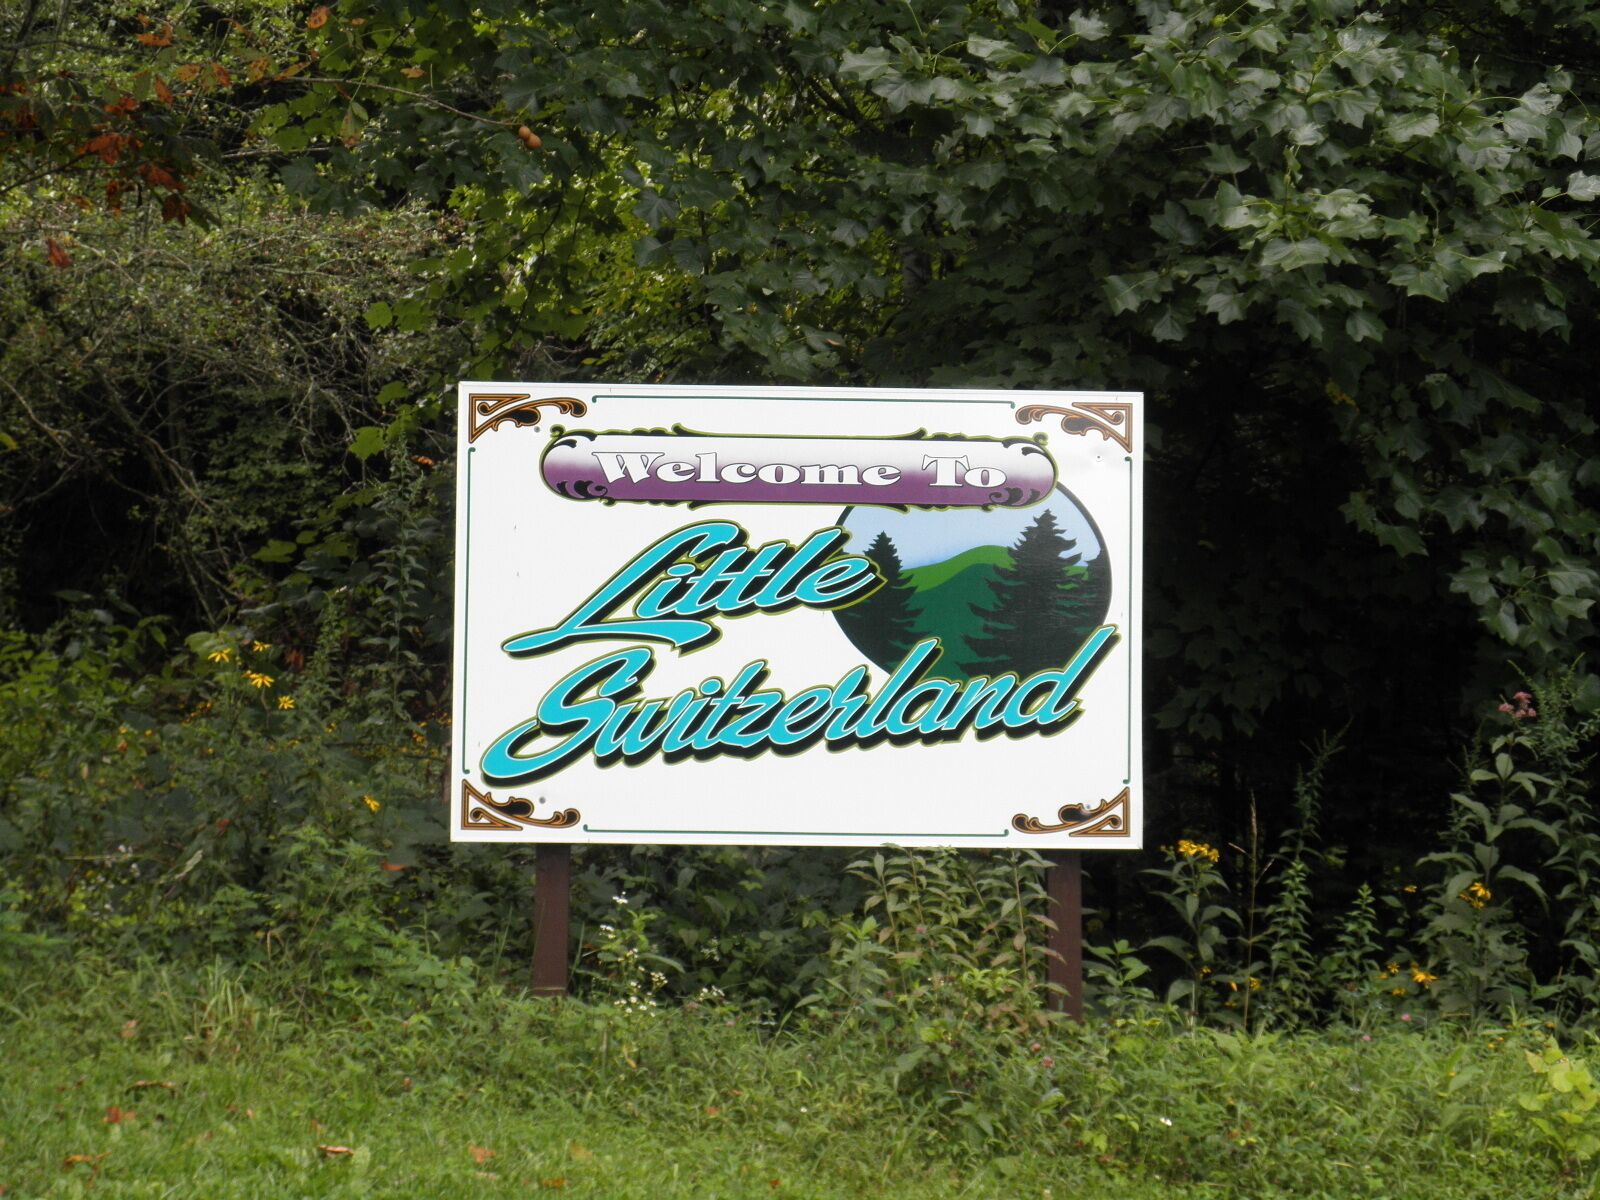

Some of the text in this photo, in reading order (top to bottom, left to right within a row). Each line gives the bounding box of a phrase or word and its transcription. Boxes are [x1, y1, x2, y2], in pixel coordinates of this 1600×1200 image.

[591, 451, 1007, 488] Welcome To
[502, 520, 884, 654] Little
[481, 625, 1117, 784] Switzerland
